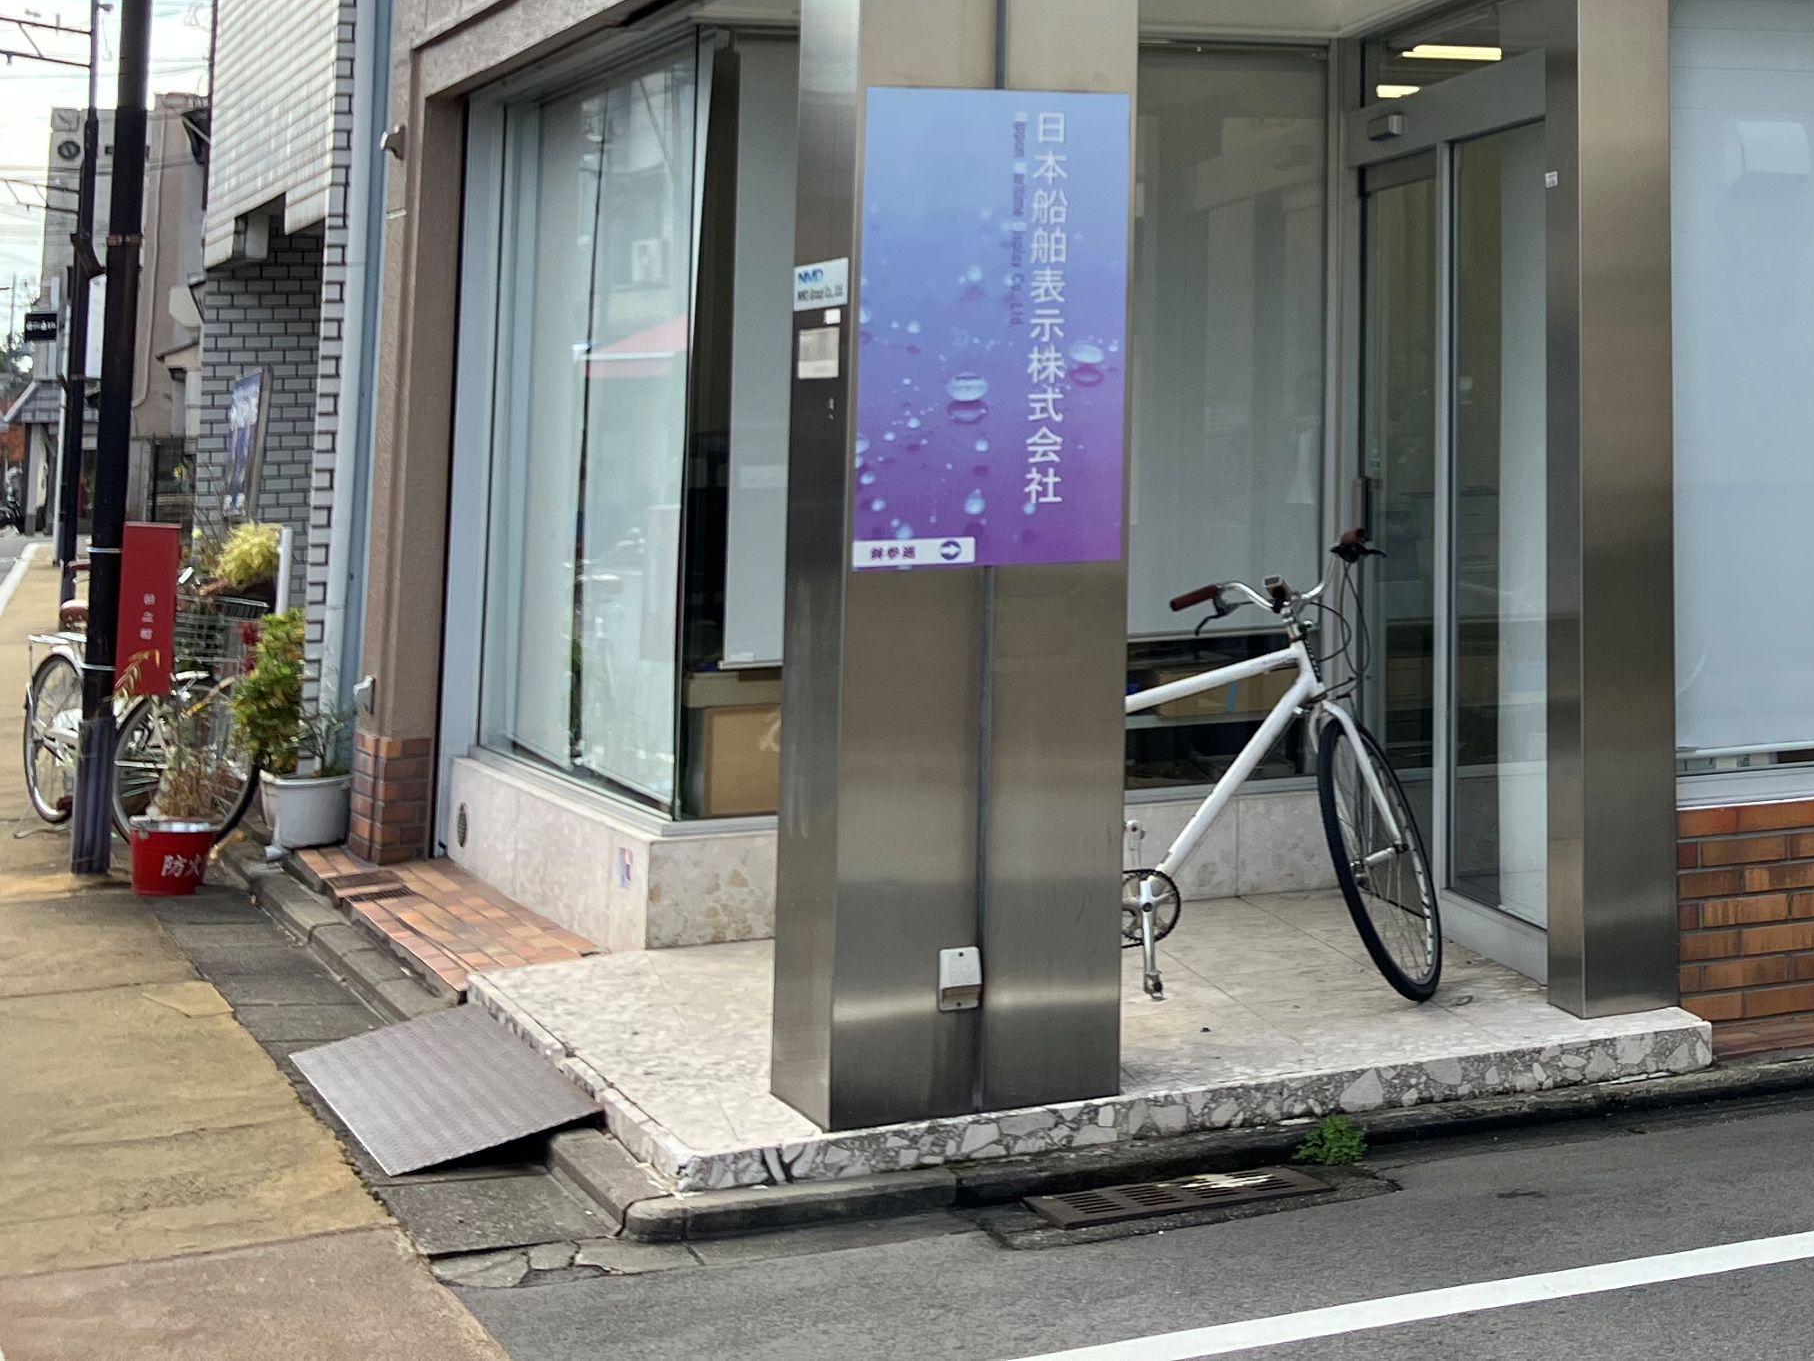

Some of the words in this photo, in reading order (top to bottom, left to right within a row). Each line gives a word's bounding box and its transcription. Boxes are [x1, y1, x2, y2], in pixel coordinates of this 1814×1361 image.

[1024, 112, 1068, 504] 日本船舶表示株式会社
